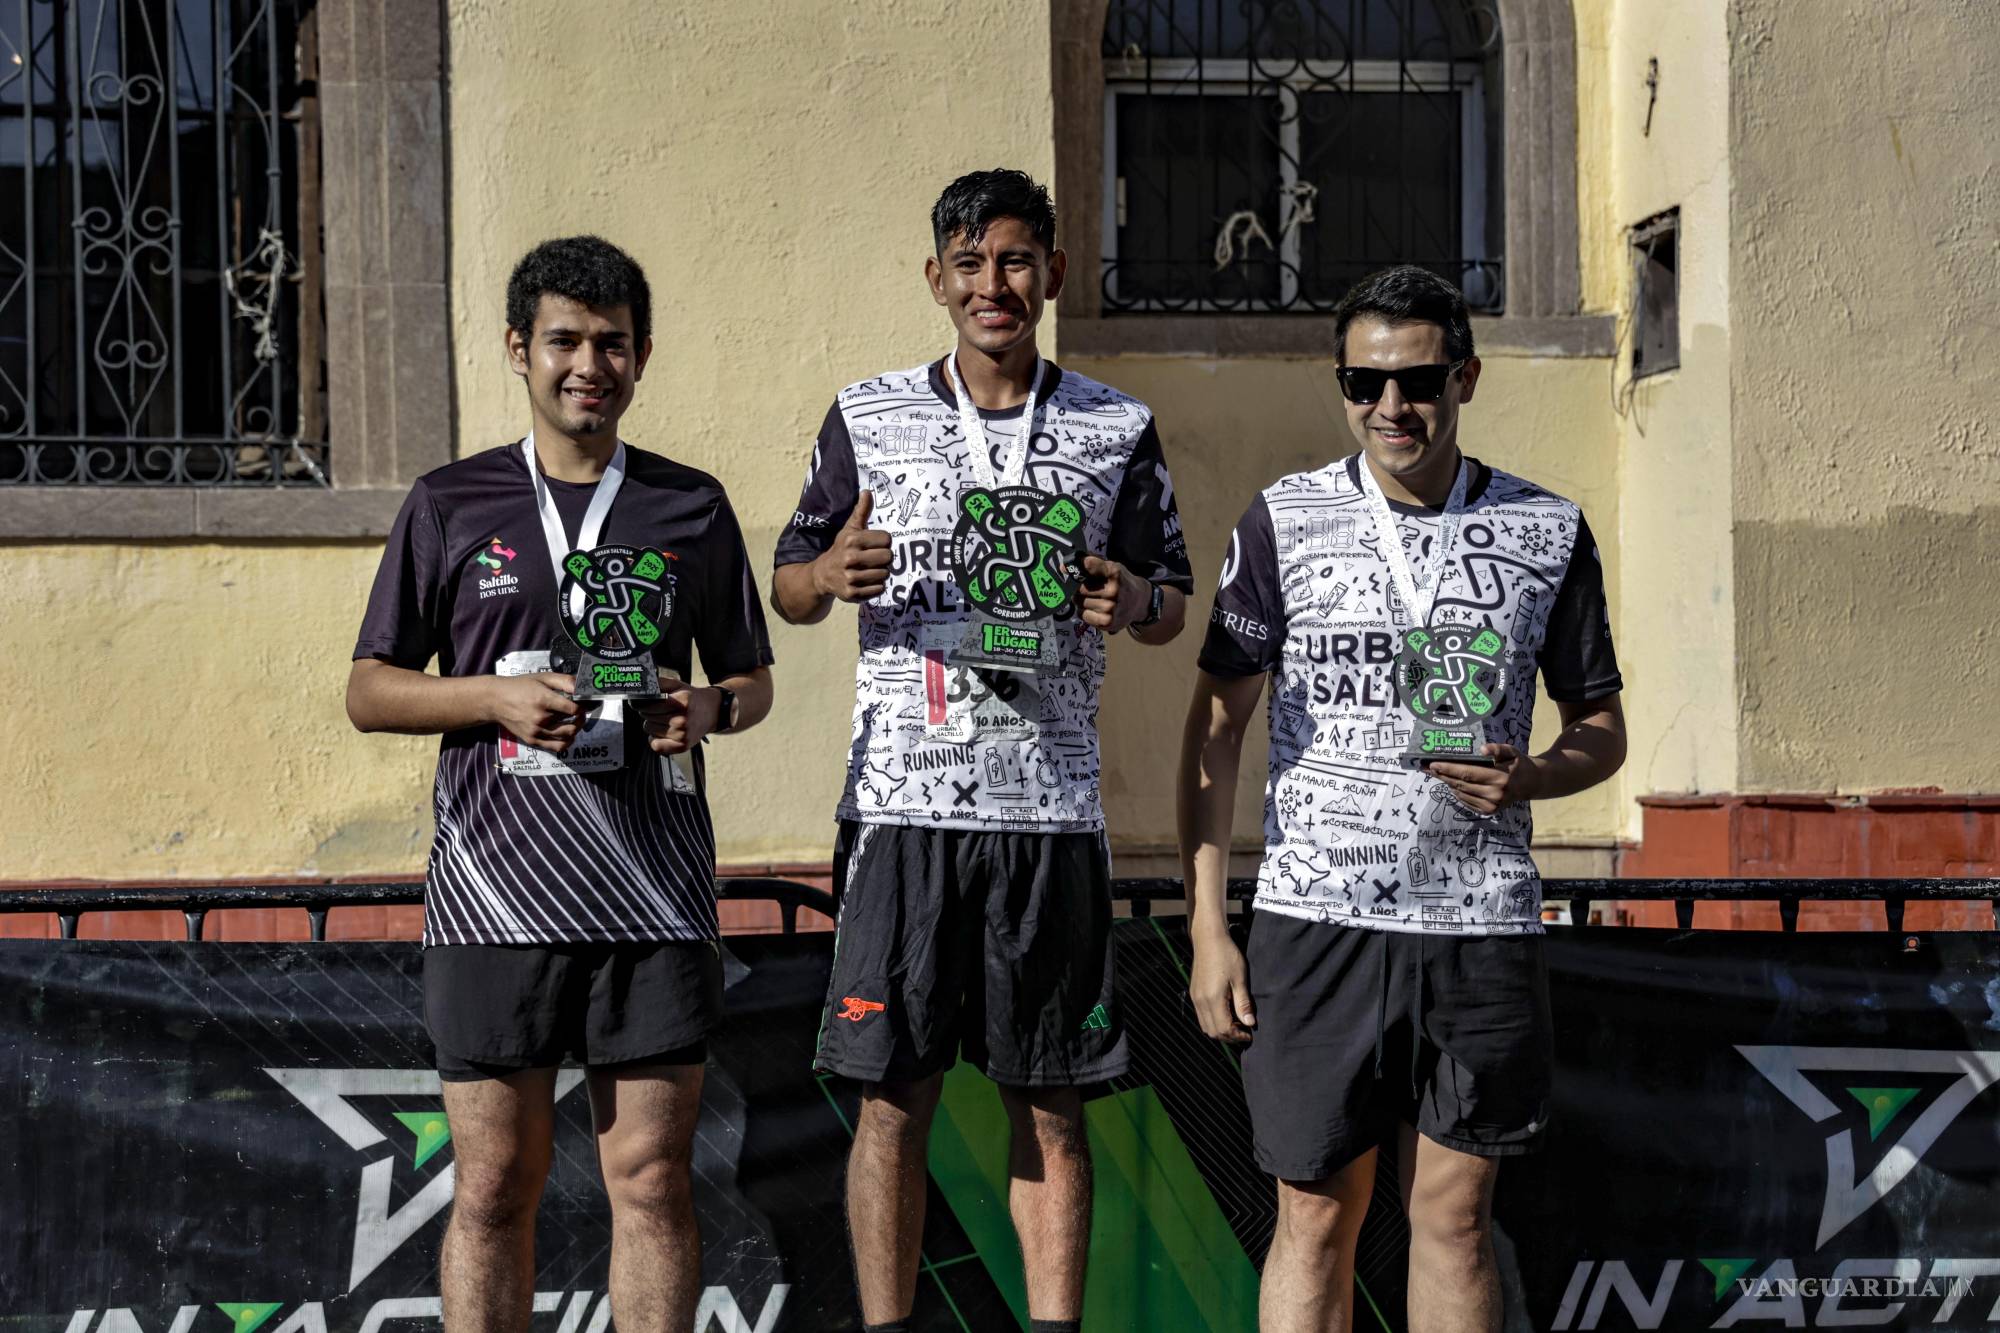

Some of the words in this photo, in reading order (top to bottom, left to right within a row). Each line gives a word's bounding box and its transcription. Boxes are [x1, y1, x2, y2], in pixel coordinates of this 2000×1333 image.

[1060, 419, 1101, 431] GENERAL
[998, 490, 1017, 499] URBAN
[1018, 490, 1045, 501] SALTILLO
[969, 497, 985, 512] 5K
[1055, 507, 1074, 524] 2025
[1494, 509, 1540, 519] GENERAL
[570, 558, 585, 571] 5K
[643, 559, 659, 573] 2025
[479, 574, 519, 590] Saltillo
[480, 589, 497, 600] nos
[497, 585, 520, 595] une.
[992, 606, 1031, 619] CORRIENDO
[1334, 620, 1387, 629] MATAMOROS
[1010, 629, 1041, 640] VARONIL
[993, 635, 1037, 650] LUGAR
[1305, 631, 1393, 665] URB
[600, 649, 632, 658] CORRIENDO
[604, 672, 641, 682] LUGAR
[992, 713, 1026, 728] AÑOS
[1432, 717, 1464, 725] CORRIENDO
[1434, 738, 1472, 747] LUGAR
[573, 744, 609, 760] AÑOS
[903, 744, 976, 773] RUNNING
[1302, 775, 1340, 791] MANUEL
[1342, 783, 1377, 797] ACUÑA
[950, 808, 978, 820] AÑOS
[1320, 817, 1409, 841] #CORRELACIUDAD
[1326, 843, 1398, 868] RUNNING
[1501, 870, 1511, 880] DE
[1514, 870, 1528, 880] 500
[1369, 904, 1398, 917] AÑOS
